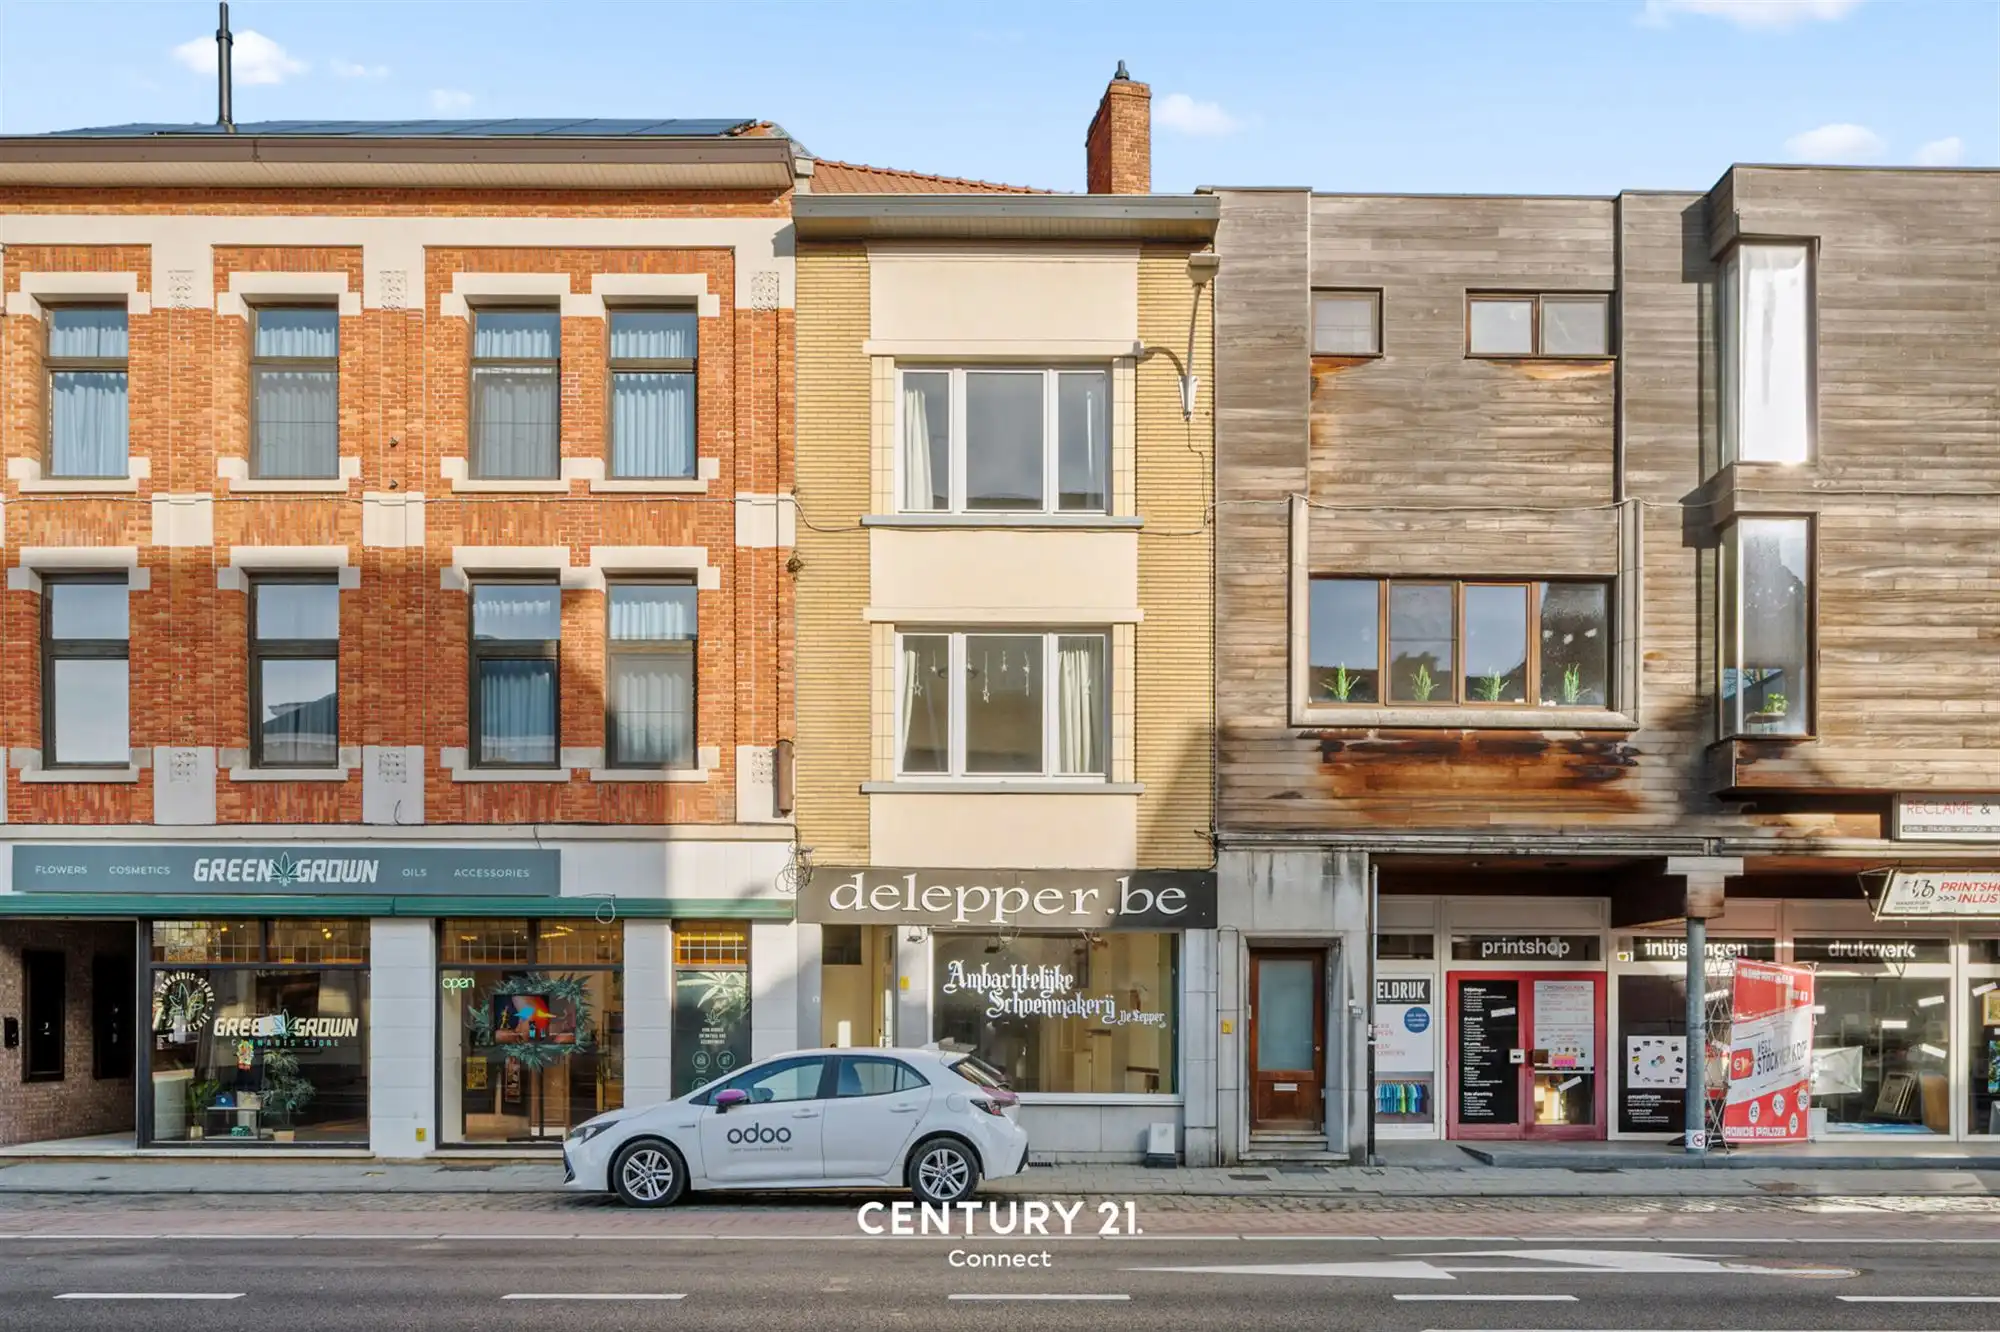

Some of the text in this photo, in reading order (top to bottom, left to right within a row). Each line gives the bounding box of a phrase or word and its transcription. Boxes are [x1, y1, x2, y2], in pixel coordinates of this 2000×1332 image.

[1907, 800, 1990, 815] RECLAME &
[35, 865, 88, 875] FLOWERS
[108, 866, 171, 875] COSMETICS
[193, 858, 379, 883] GREEN GROWN
[402, 868, 427, 877] OILS
[453, 868, 530, 878] ACCESSORIES
[829, 872, 1189, 924] delepper.be
[1482, 937, 1570, 958] printshop
[1644, 938, 1748, 962] inlijsngen
[1827, 940, 1916, 958] drukwerk
[159, 972, 196, 994] CANNABIS
[442, 978, 475, 996] open
[1377, 981, 1425, 999] ELDRUK
[295, 1018, 359, 1037] GROWN
[304, 1039, 340, 1047] STORE
[727, 1122, 791, 1144] odoo
